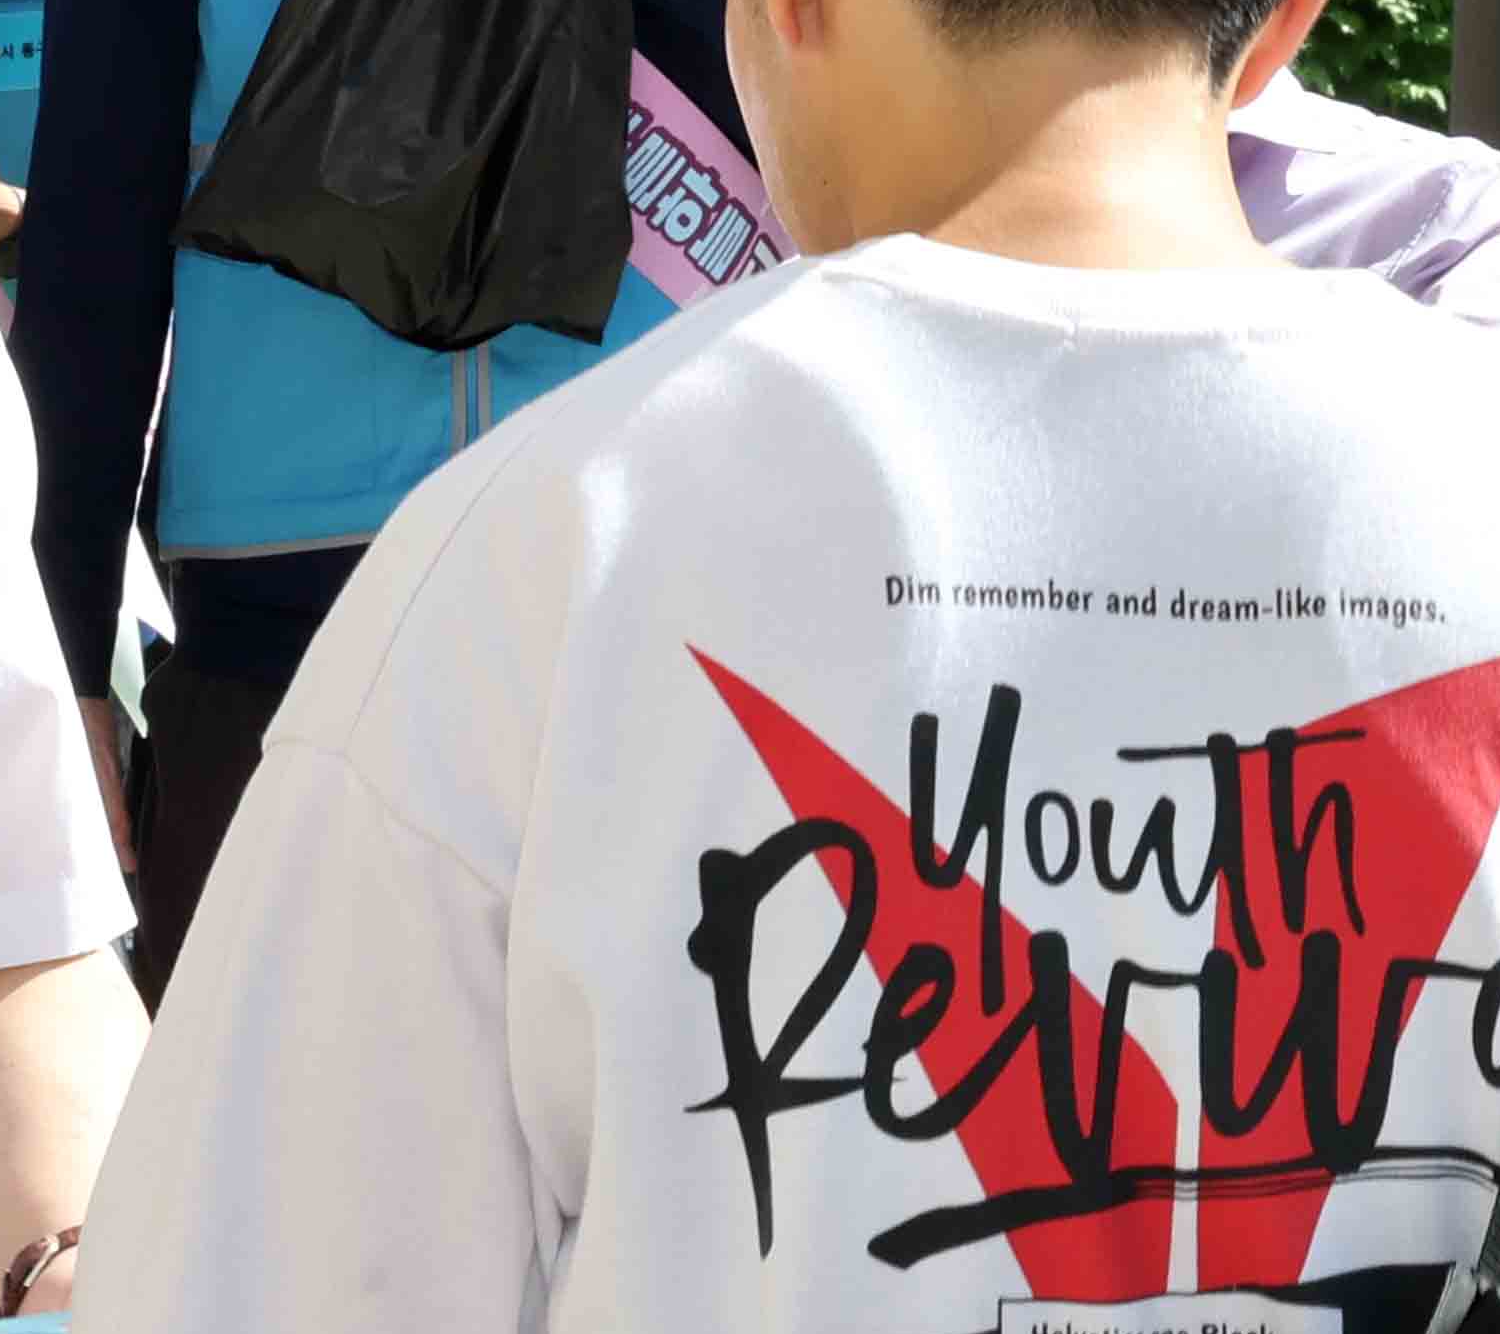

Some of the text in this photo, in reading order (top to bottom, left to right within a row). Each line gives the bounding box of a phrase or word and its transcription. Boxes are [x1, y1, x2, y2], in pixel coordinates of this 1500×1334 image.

[884, 574, 1447, 628] Dim remember and dream-like images.
[909, 683, 1365, 1018] Youth
